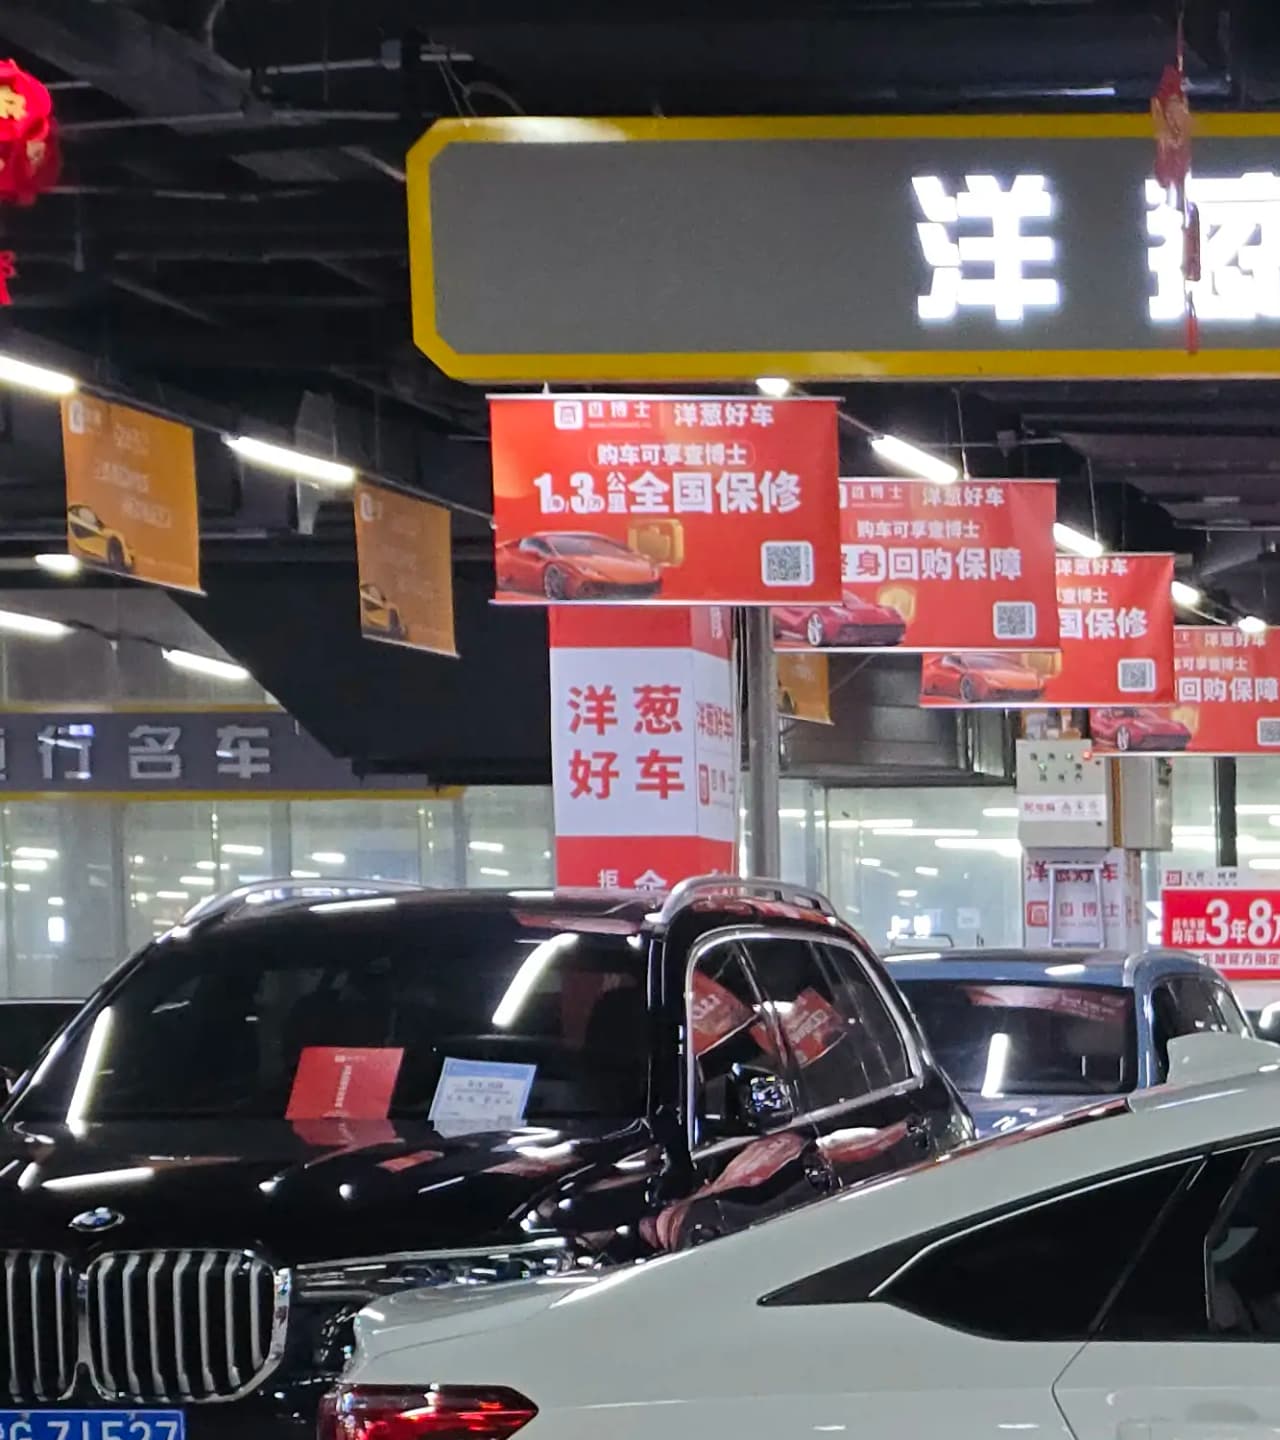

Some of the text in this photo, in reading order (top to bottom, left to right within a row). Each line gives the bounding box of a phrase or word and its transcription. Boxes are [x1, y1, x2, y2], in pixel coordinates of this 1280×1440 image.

[674, 403, 775, 427] 洋葱好车
[597, 443, 747, 466] 购车可享查博士
[923, 487, 1005, 507] 洋葱好车
[857, 520, 980, 539] 购车可享查博士
[841, 547, 1022, 581] 身回购保障
[1057, 587, 1108, 604] 查博士
[568, 684, 682, 736] 洋葱
[0, 723, 272, 780] 行名车
[569, 748, 685, 800] 好车
